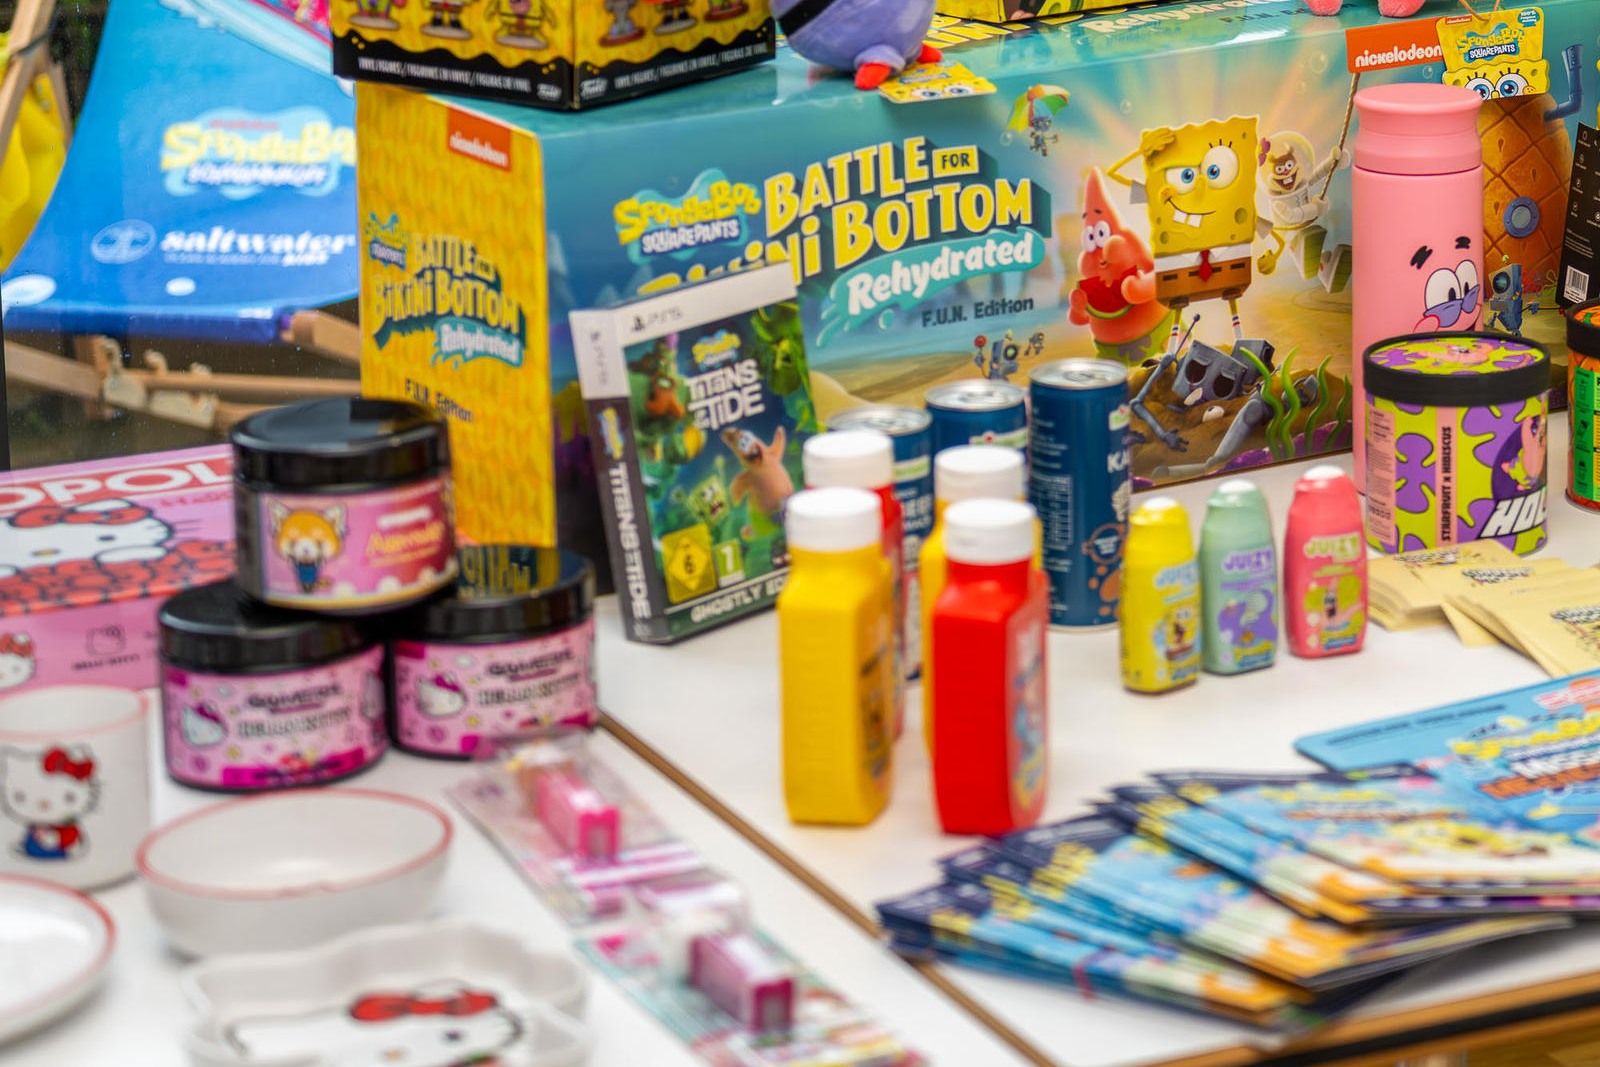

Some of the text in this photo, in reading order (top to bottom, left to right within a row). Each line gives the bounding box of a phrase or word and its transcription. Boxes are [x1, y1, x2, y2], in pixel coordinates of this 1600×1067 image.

[1355, 44, 1443, 68] nickelodeon
[1456, 27, 1525, 54] SpongeBob
[1469, 45, 1515, 59] SQUAREPANTS
[764, 136, 970, 239] BATTLE FOR
[614, 180, 762, 246] SpongeBob
[834, 178, 1033, 271] BOTTOM
[413, 233, 473, 275] BATTLE
[642, 219, 740, 254] SQUAREPANTS
[846, 232, 1034, 315] Rehydrated
[434, 270, 521, 332] BOTTOM
[922, 295, 1034, 328] F.U.N. Edition
[1441, 485, 1452, 542] STARFRUIT
[691, 583, 762, 623] GHOSTLY
